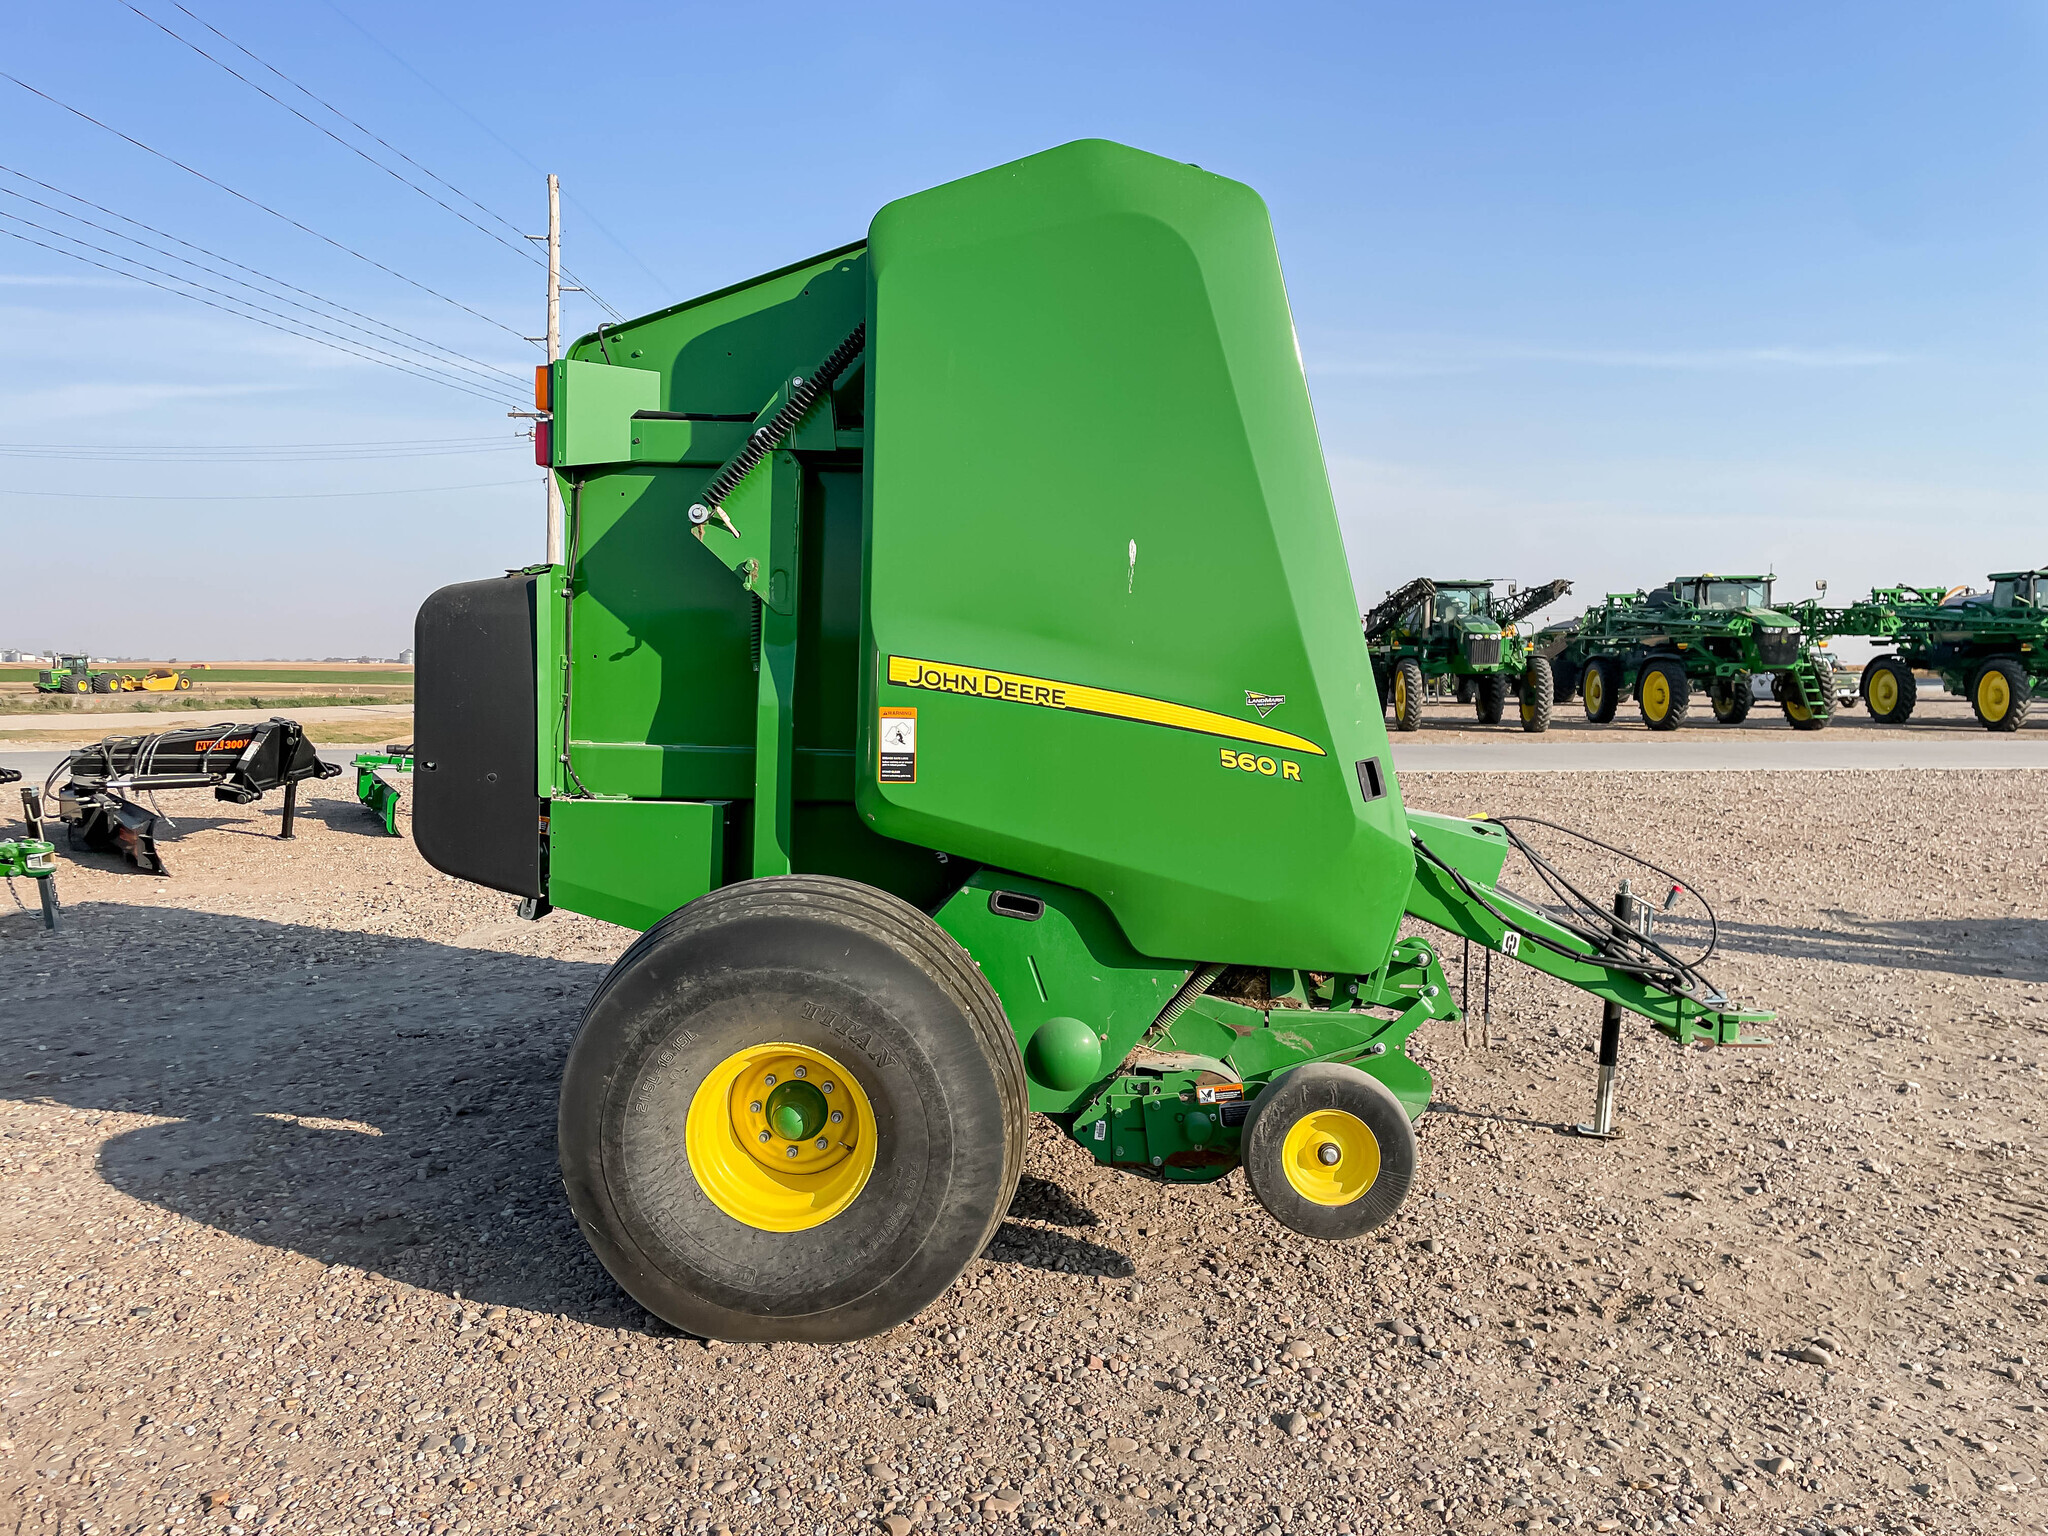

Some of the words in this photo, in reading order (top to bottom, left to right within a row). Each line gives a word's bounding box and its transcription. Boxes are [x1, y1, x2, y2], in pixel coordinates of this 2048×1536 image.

[909, 664, 977, 692] JOHN
[984, 674, 1067, 706] DEERE
[1219, 747, 1277, 776] 560
[1281, 758, 1303, 782] R
[801, 1000, 899, 1068] TITAN
